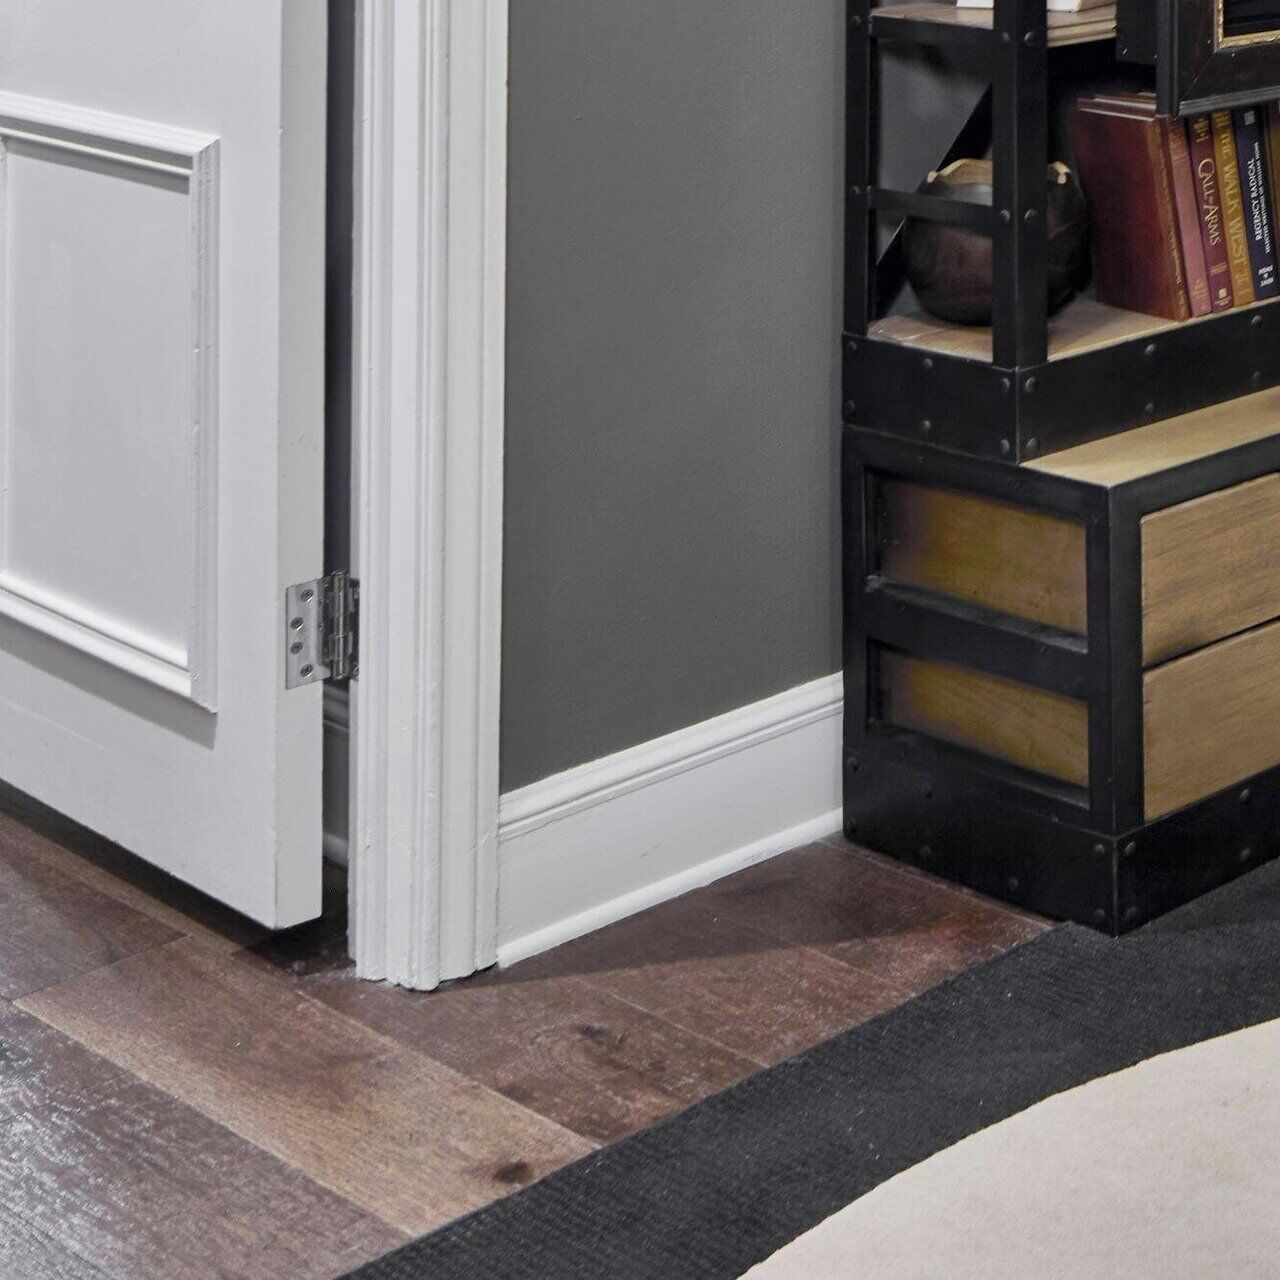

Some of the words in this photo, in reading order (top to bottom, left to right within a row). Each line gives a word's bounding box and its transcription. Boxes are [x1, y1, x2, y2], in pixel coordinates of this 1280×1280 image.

[1198, 159, 1216, 200] CALL
[1223, 164, 1239, 213] WALK
[1247, 158, 1259, 198] RADICAL
[1204, 205, 1221, 247] ARMS
[1230, 217, 1246, 264] WEST
[1252, 200, 1263, 241] REGENCY
